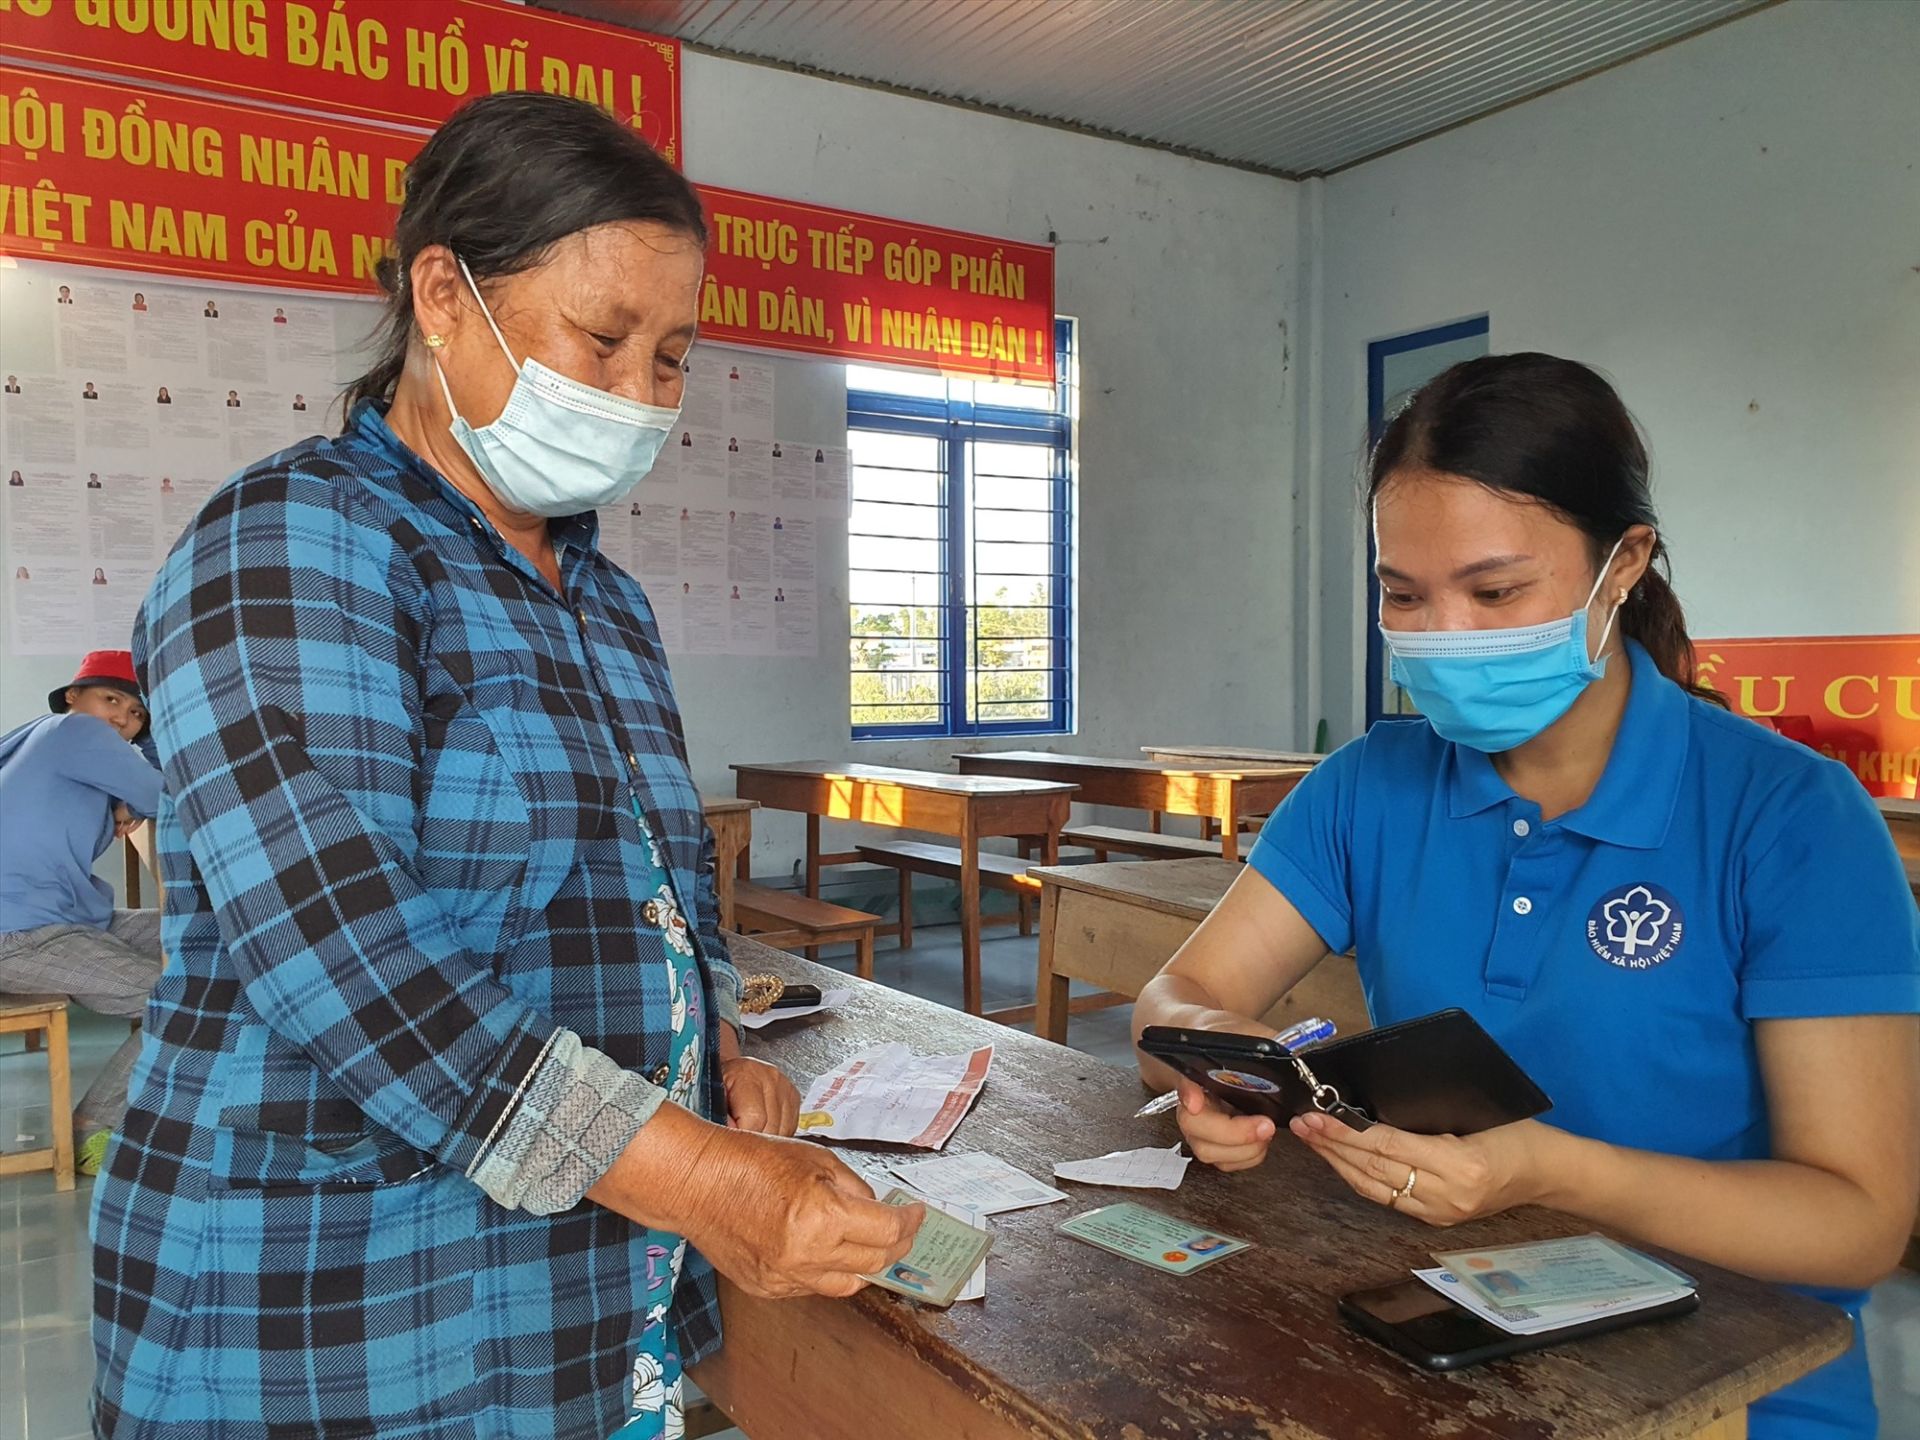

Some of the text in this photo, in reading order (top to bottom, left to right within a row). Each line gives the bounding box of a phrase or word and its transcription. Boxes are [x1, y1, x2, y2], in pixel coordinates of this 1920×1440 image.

[286, 0, 389, 80] BÁC
[406, 17, 469, 95] HỒ
[484, 38, 530, 94] VĨ
[631, 75, 643, 129] !
[0, 87, 64, 162] ỘI
[82, 99, 223, 178] ĐỒNG
[240, 136, 369, 200] NHÂN
[110, 200, 227, 261] NAM
[245, 208, 338, 276] CỦA
[713, 213, 1025, 300] TRỰC TIẾP GÓP PHẦN
[759, 286, 834, 344] DÂN,
[844, 296, 872, 344] VÌ
[881, 307, 961, 355] NHÂN
[971, 316, 1026, 364] DÂN
[1036, 331, 1043, 365] !
[1630, 957, 1651, 969] HỘI
[1652, 943, 1674, 963] VIỆT
[1670, 922, 1682, 945] NAM
